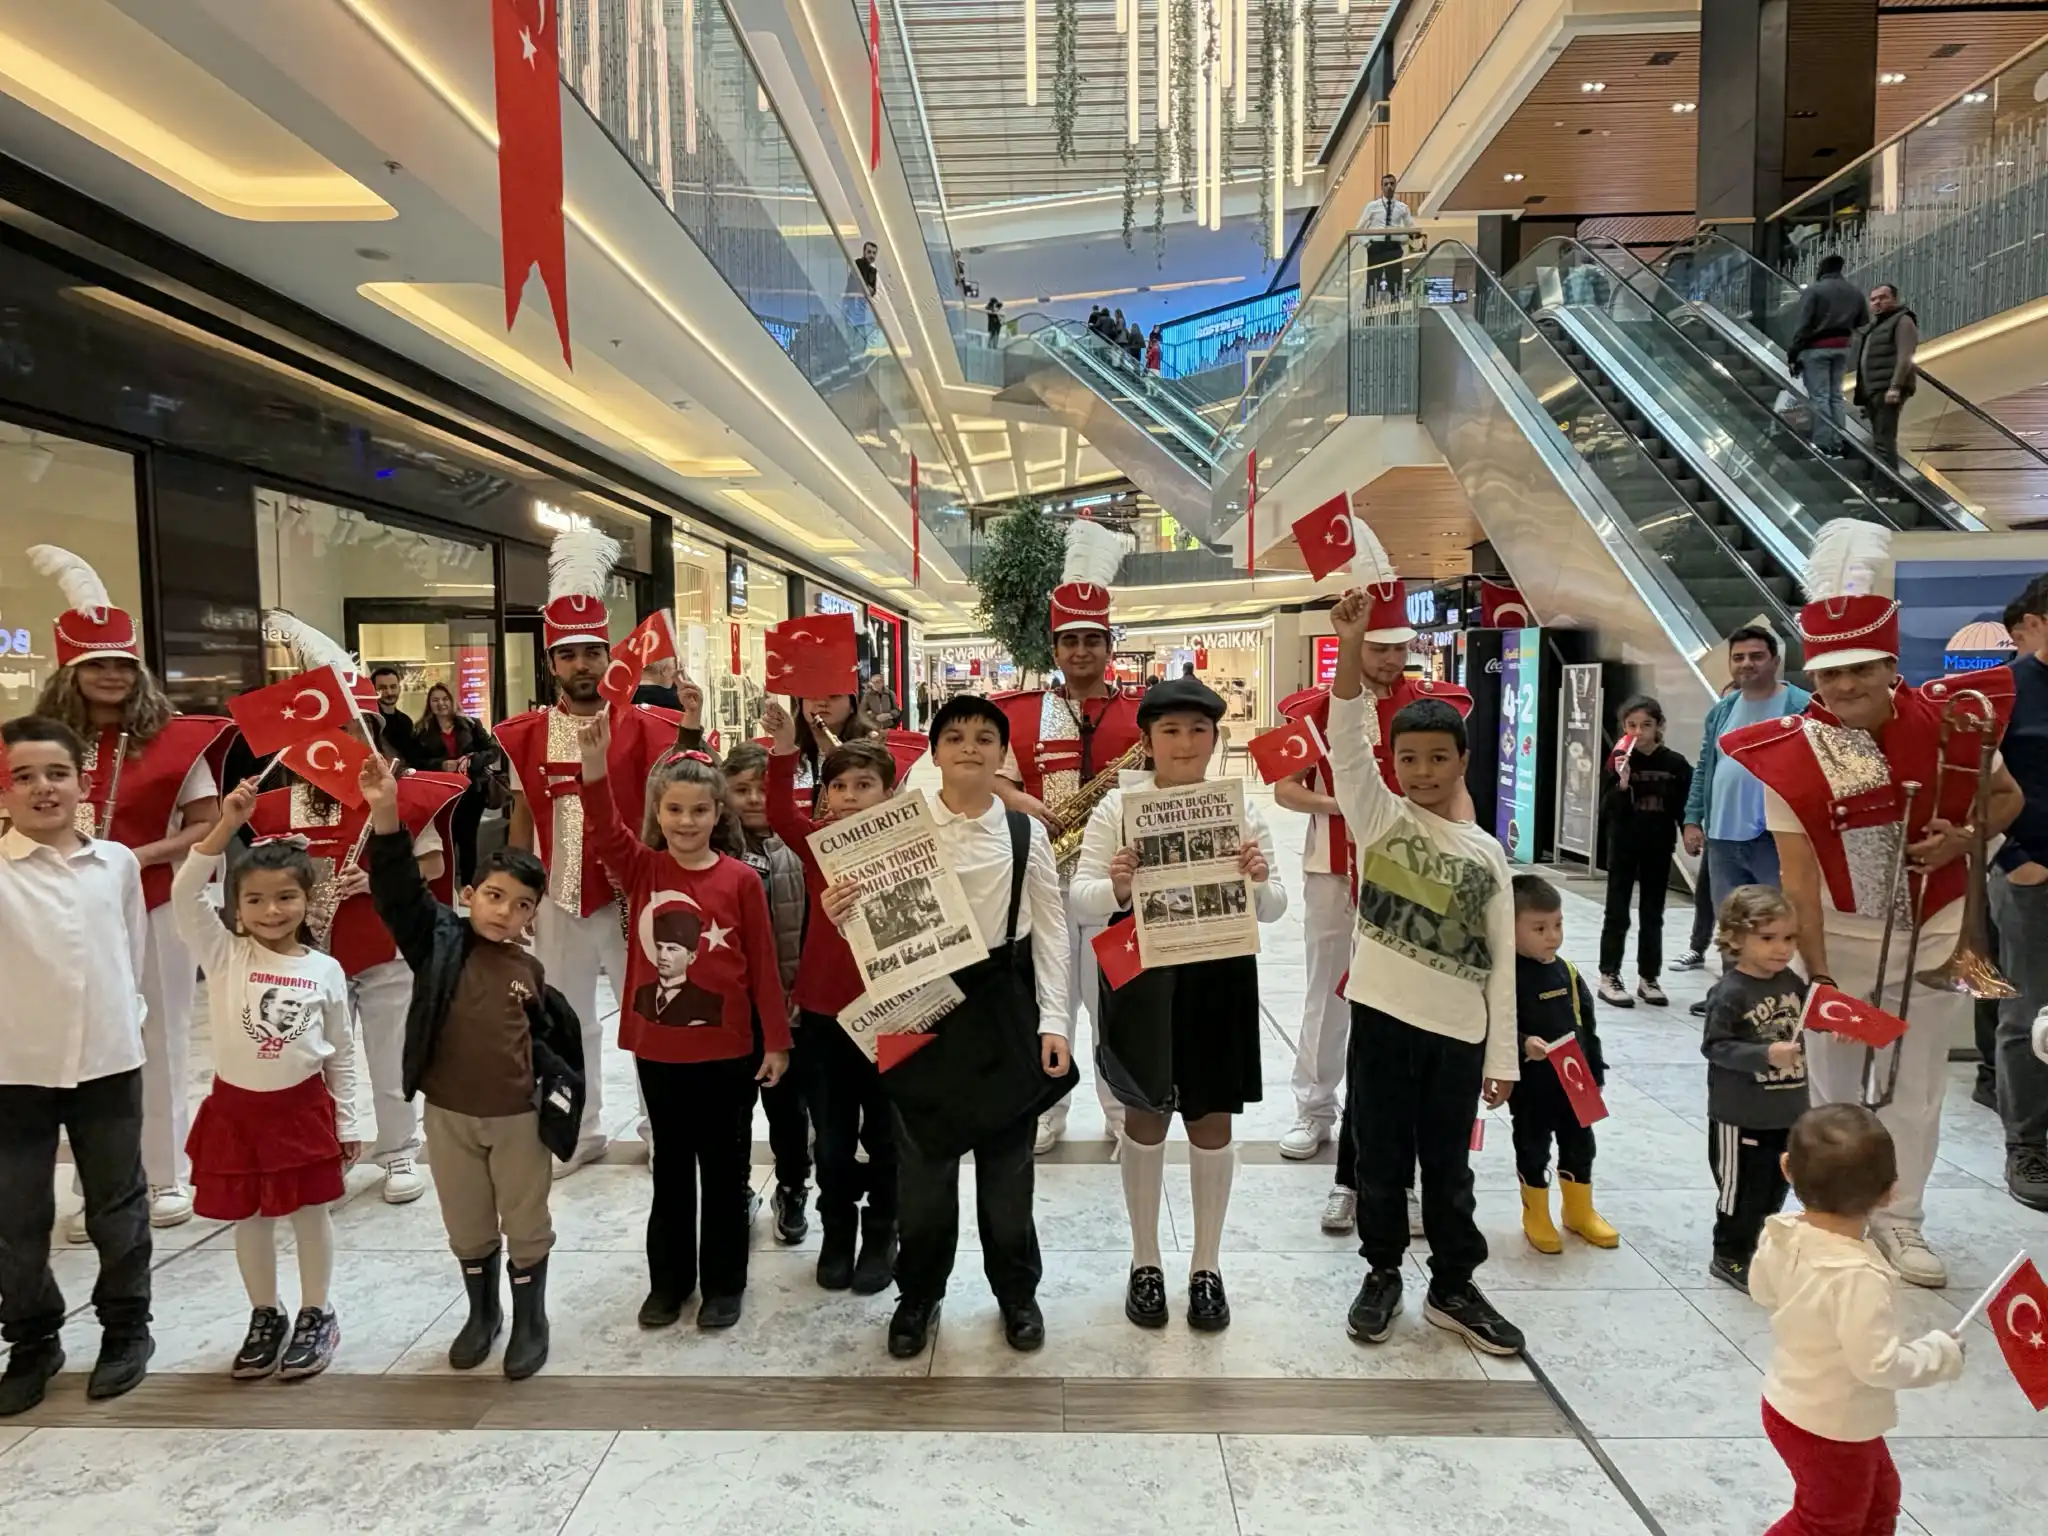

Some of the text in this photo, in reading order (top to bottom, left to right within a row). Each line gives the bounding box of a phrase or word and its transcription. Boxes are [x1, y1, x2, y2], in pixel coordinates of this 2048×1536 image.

[1135, 804, 1234, 827] CUMHURİYET
[1141, 799, 1183, 814] DÜNDEN
[820, 802, 921, 854] CUMHURİYET
[249, 972, 318, 991] CUMHURİYET
[1743, 996, 1776, 1026] TOP
[259, 1037, 284, 1051] 29
